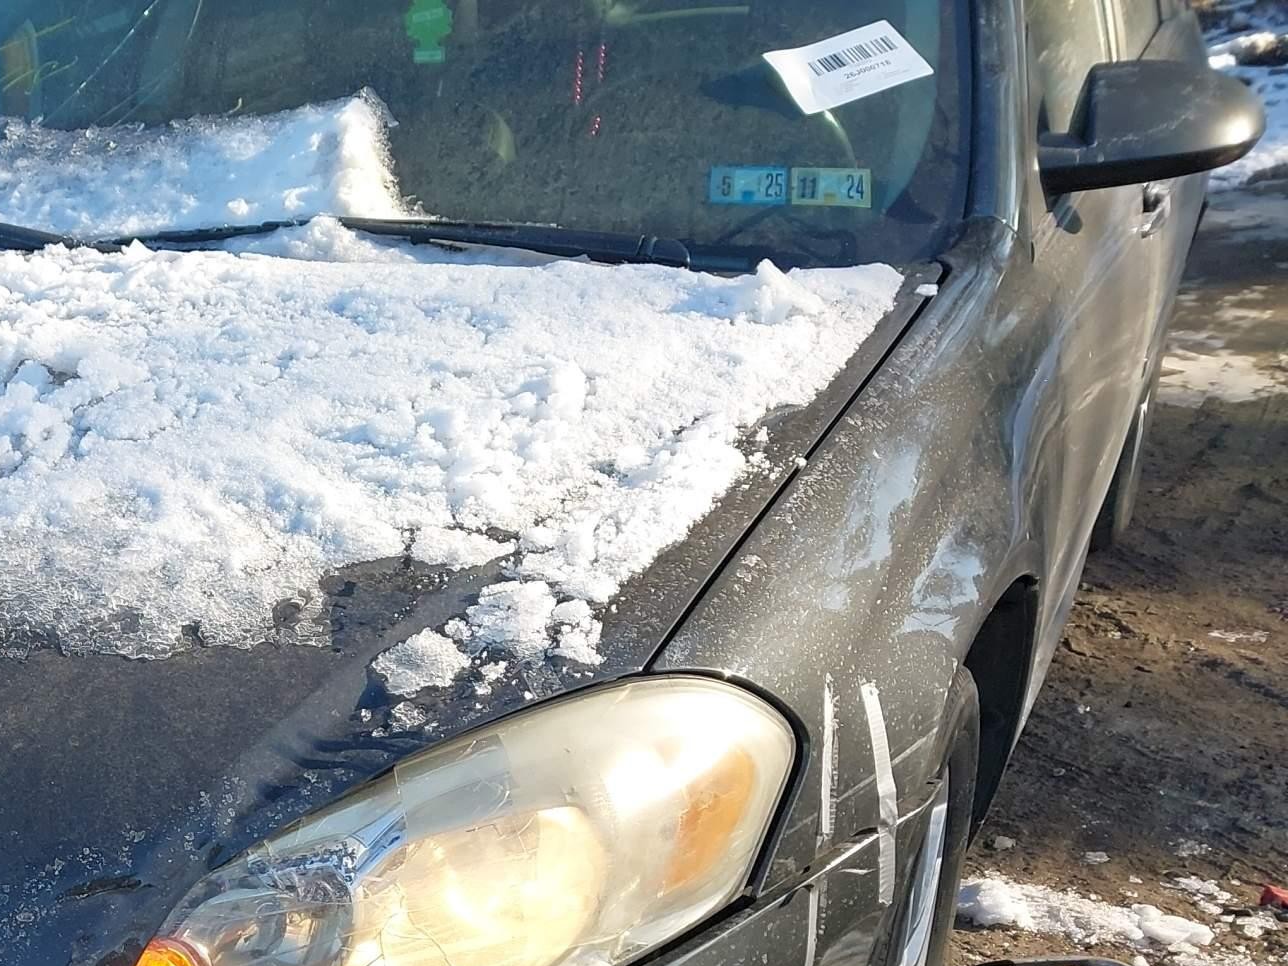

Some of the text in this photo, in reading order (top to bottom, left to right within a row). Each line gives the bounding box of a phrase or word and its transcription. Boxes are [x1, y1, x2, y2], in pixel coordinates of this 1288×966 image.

[721, 173, 784, 198] 5 25
[799, 174, 865, 200] 11 24
